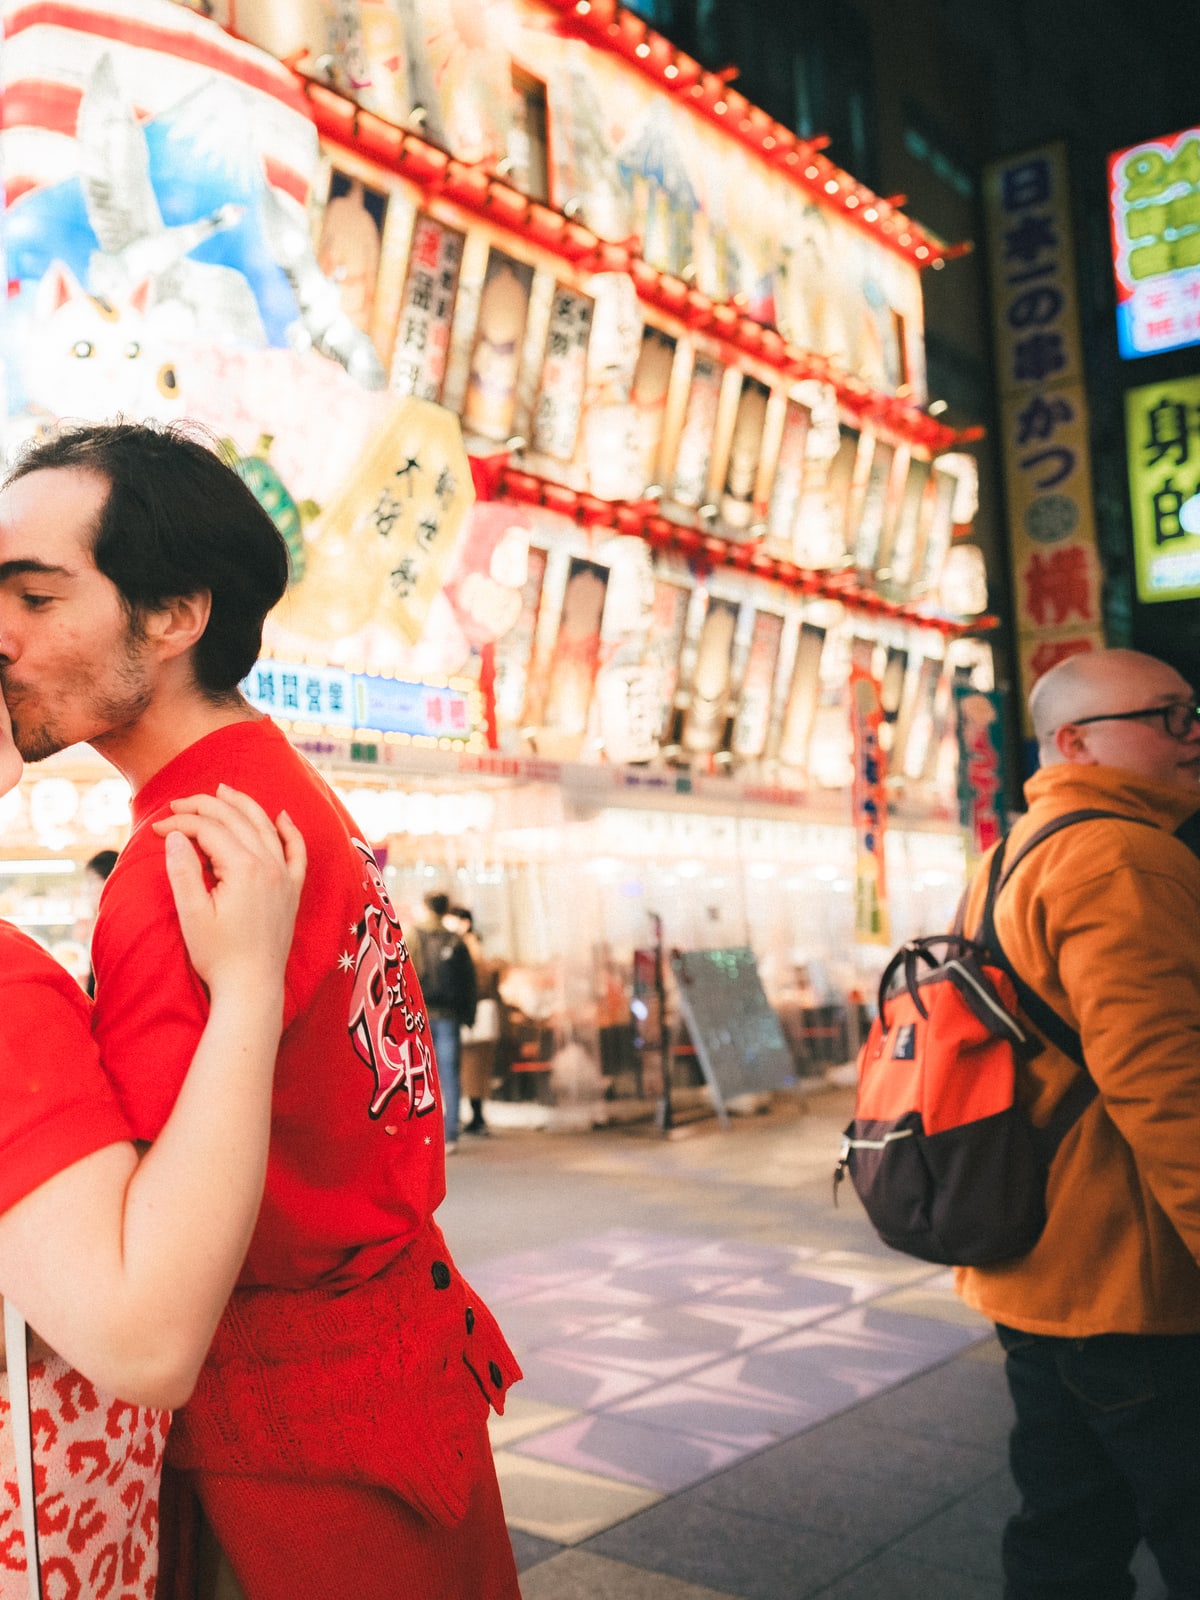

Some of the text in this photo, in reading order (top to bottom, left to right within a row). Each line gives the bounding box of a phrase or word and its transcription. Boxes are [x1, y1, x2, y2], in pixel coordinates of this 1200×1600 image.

[1002, 160, 1076, 490] 日本一の串かつ
[246, 671, 344, 712] 時間営業
